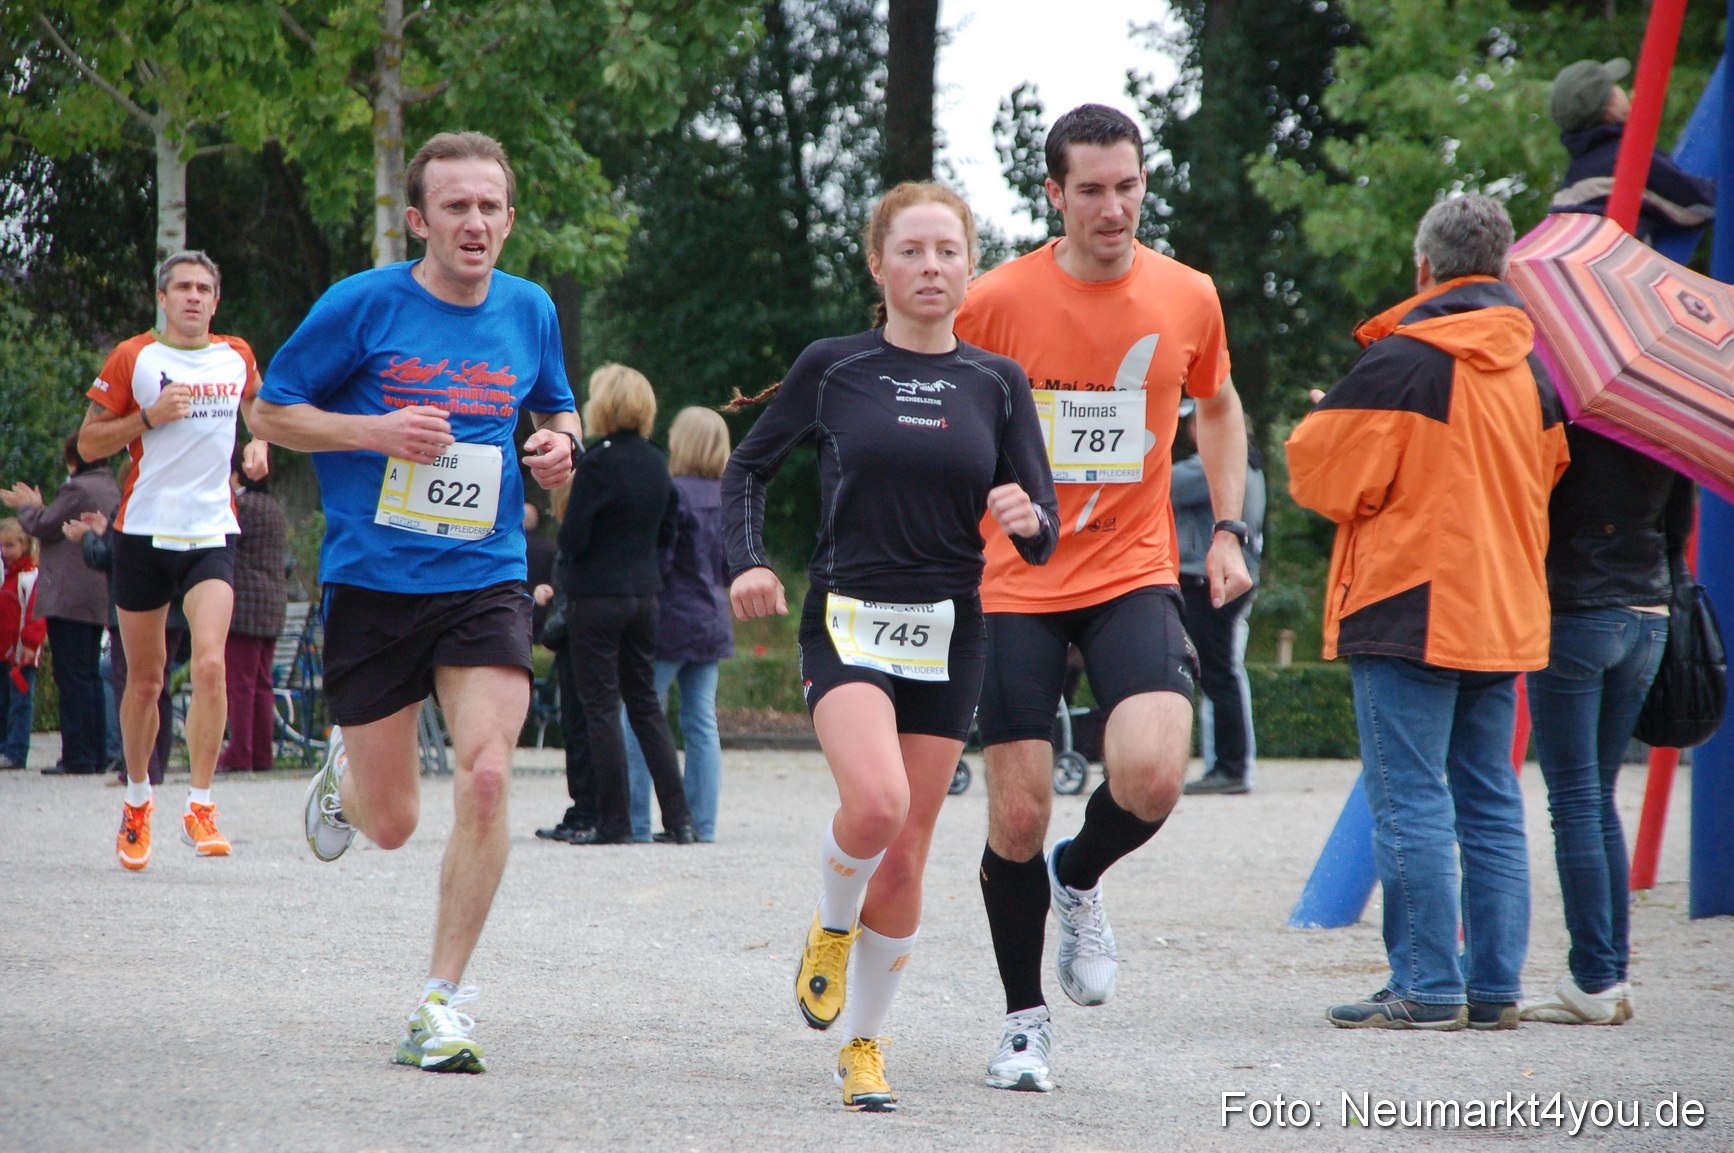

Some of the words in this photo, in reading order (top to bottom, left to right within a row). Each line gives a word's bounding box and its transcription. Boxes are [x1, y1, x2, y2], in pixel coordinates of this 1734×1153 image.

[1045, 378, 1079, 392] Mai
[188, 395, 230, 406] eisen
[1060, 400, 1118, 418] Thomas
[898, 415, 941, 428] cocoon
[1071, 428, 1125, 453] 787
[428, 453, 459, 470] ené
[389, 467, 398, 482] A
[1098, 469, 1142, 478] PFLEIDERER
[427, 479, 482, 509] 622
[832, 615, 840, 630] A
[872, 620, 931, 648] 745
[902, 665, 946, 676] PFLEIDERER
